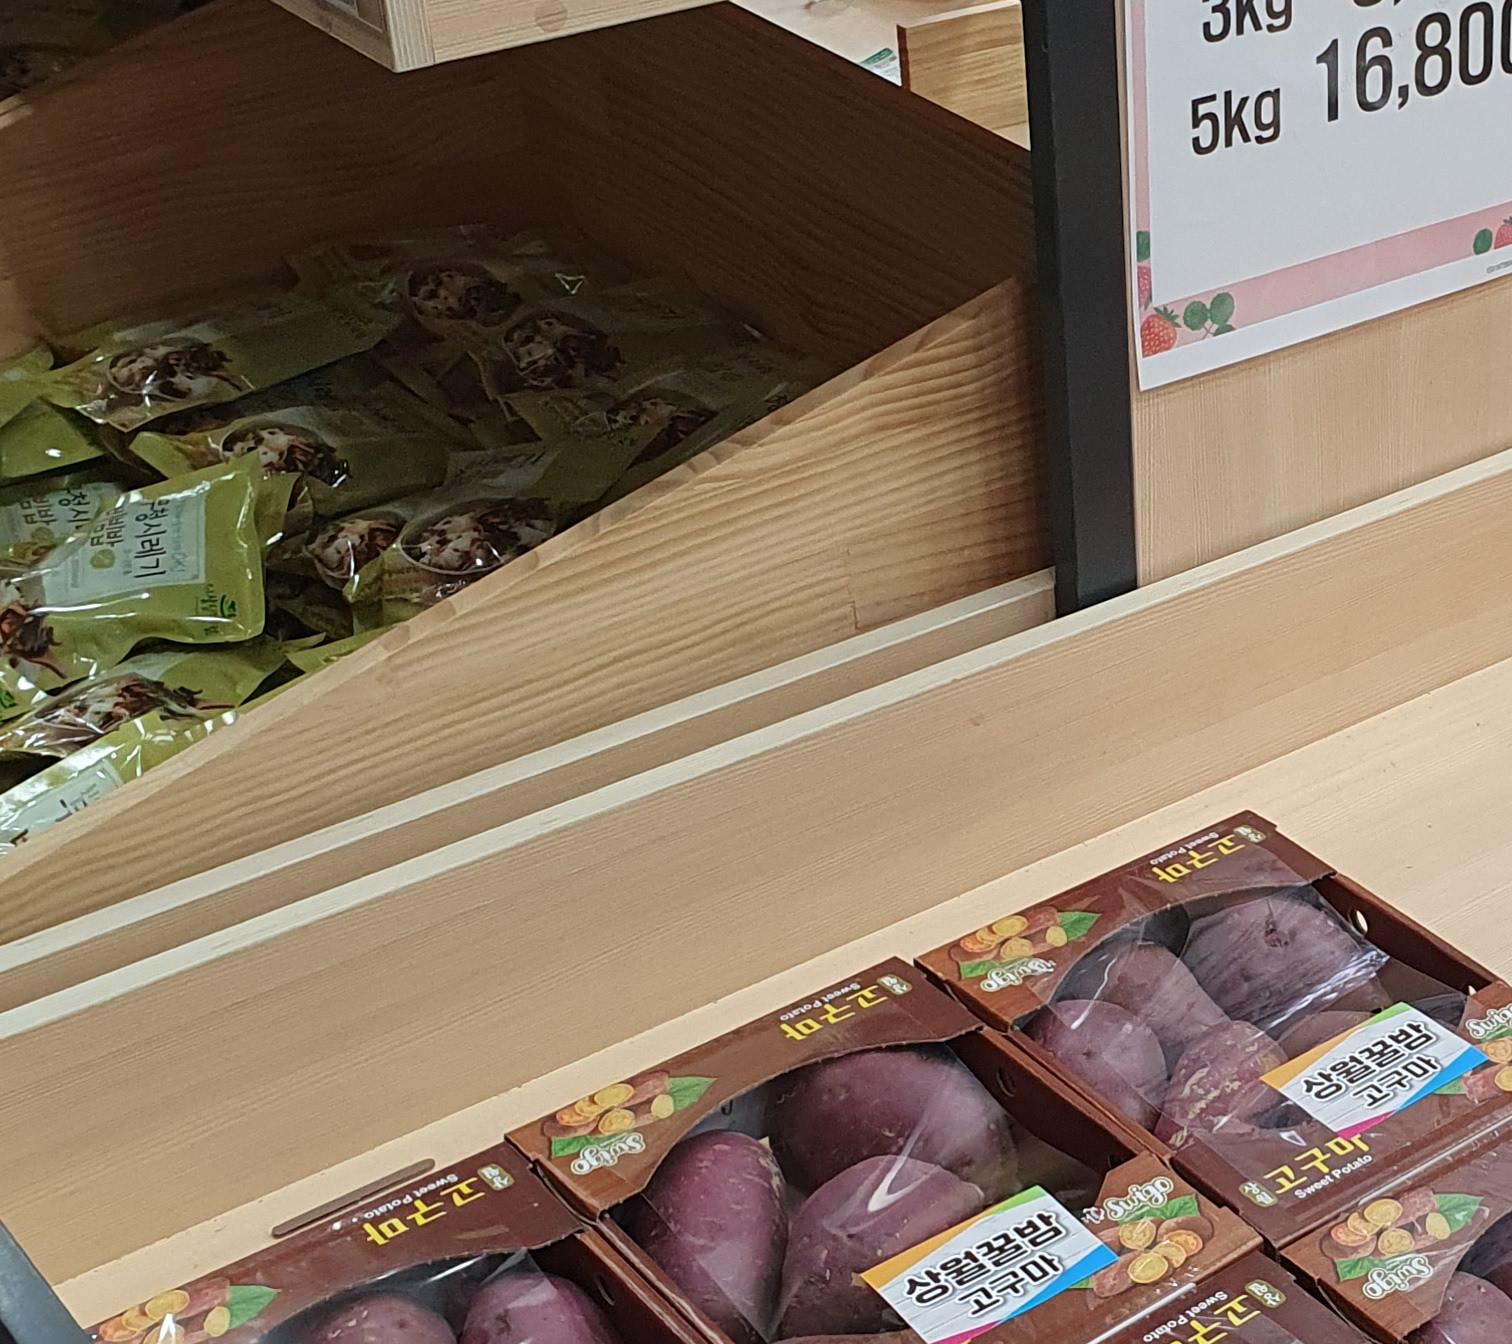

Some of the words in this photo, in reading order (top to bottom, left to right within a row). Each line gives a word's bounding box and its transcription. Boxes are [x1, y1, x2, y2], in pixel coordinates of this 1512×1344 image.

[1190, 83, 1282, 156] 5kg
[1151, 835, 1246, 884] 고구마
[780, 984, 889, 1041] 고구마
[1301, 1018, 1440, 1102] 상월꿀밤
[1350, 1053, 1443, 1111] 고구마
[570, 1131, 647, 1176] Swigo
[1263, 1132, 1371, 1195] 고구마
[363, 1176, 487, 1246] 고구마
[413, 1173, 459, 1200] Sweet
[1102, 1176, 1174, 1222] Swigo
[903, 1211, 1065, 1308] 상월꿀밤
[958, 1253, 1064, 1317] 고구마
[1362, 1255, 1433, 1300] Swigo
